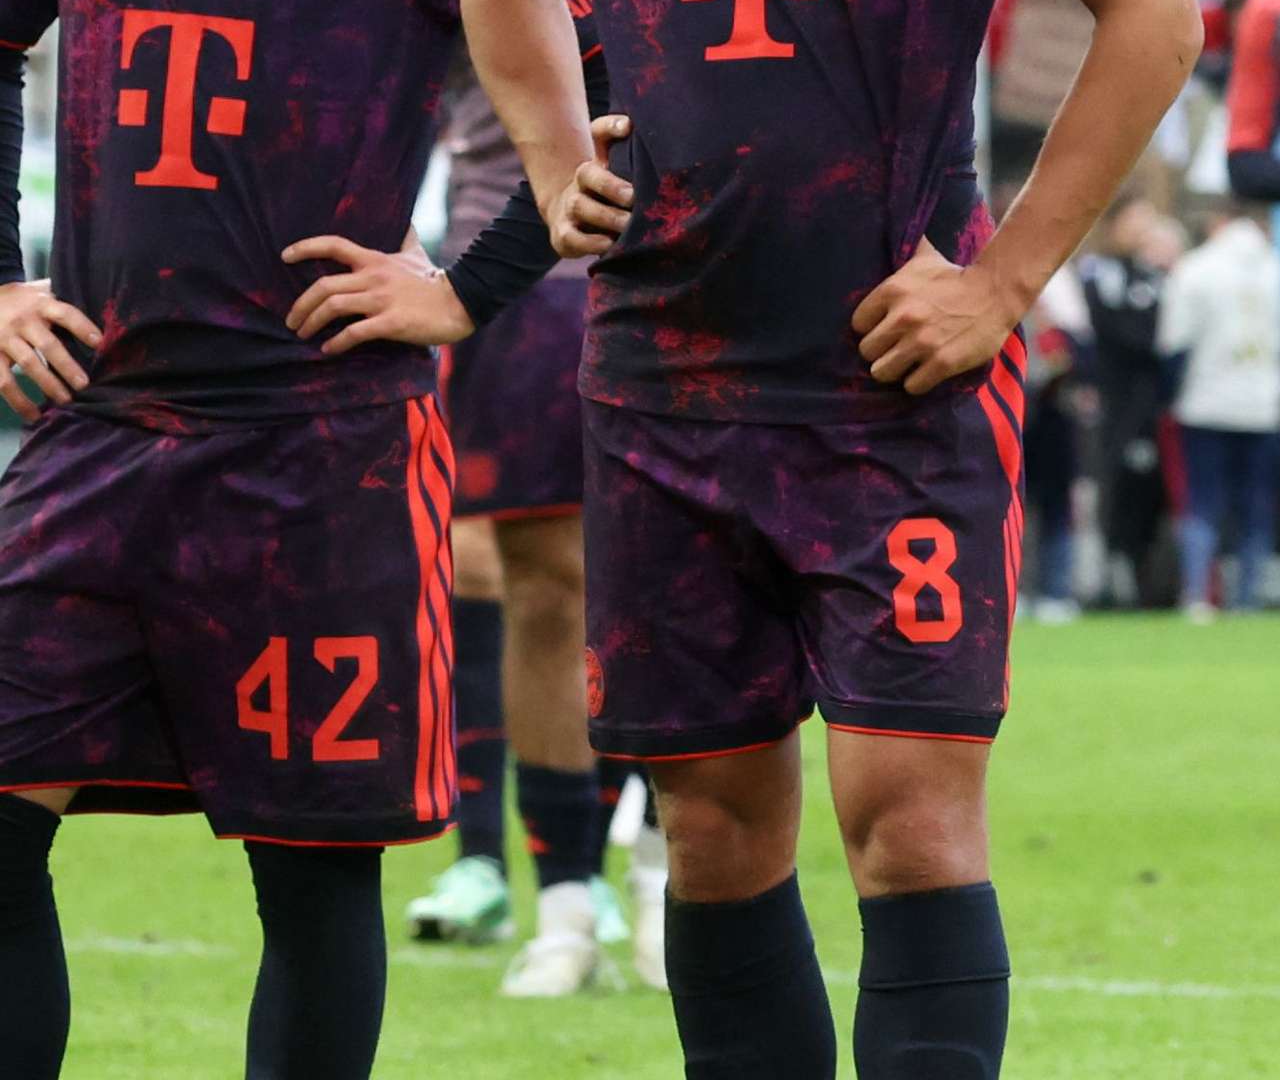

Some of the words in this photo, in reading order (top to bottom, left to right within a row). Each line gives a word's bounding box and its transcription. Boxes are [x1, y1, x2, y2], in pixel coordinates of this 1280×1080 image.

[117, 9, 255, 190] T
[886, 517, 963, 643] 8
[235, 635, 380, 762] 42
